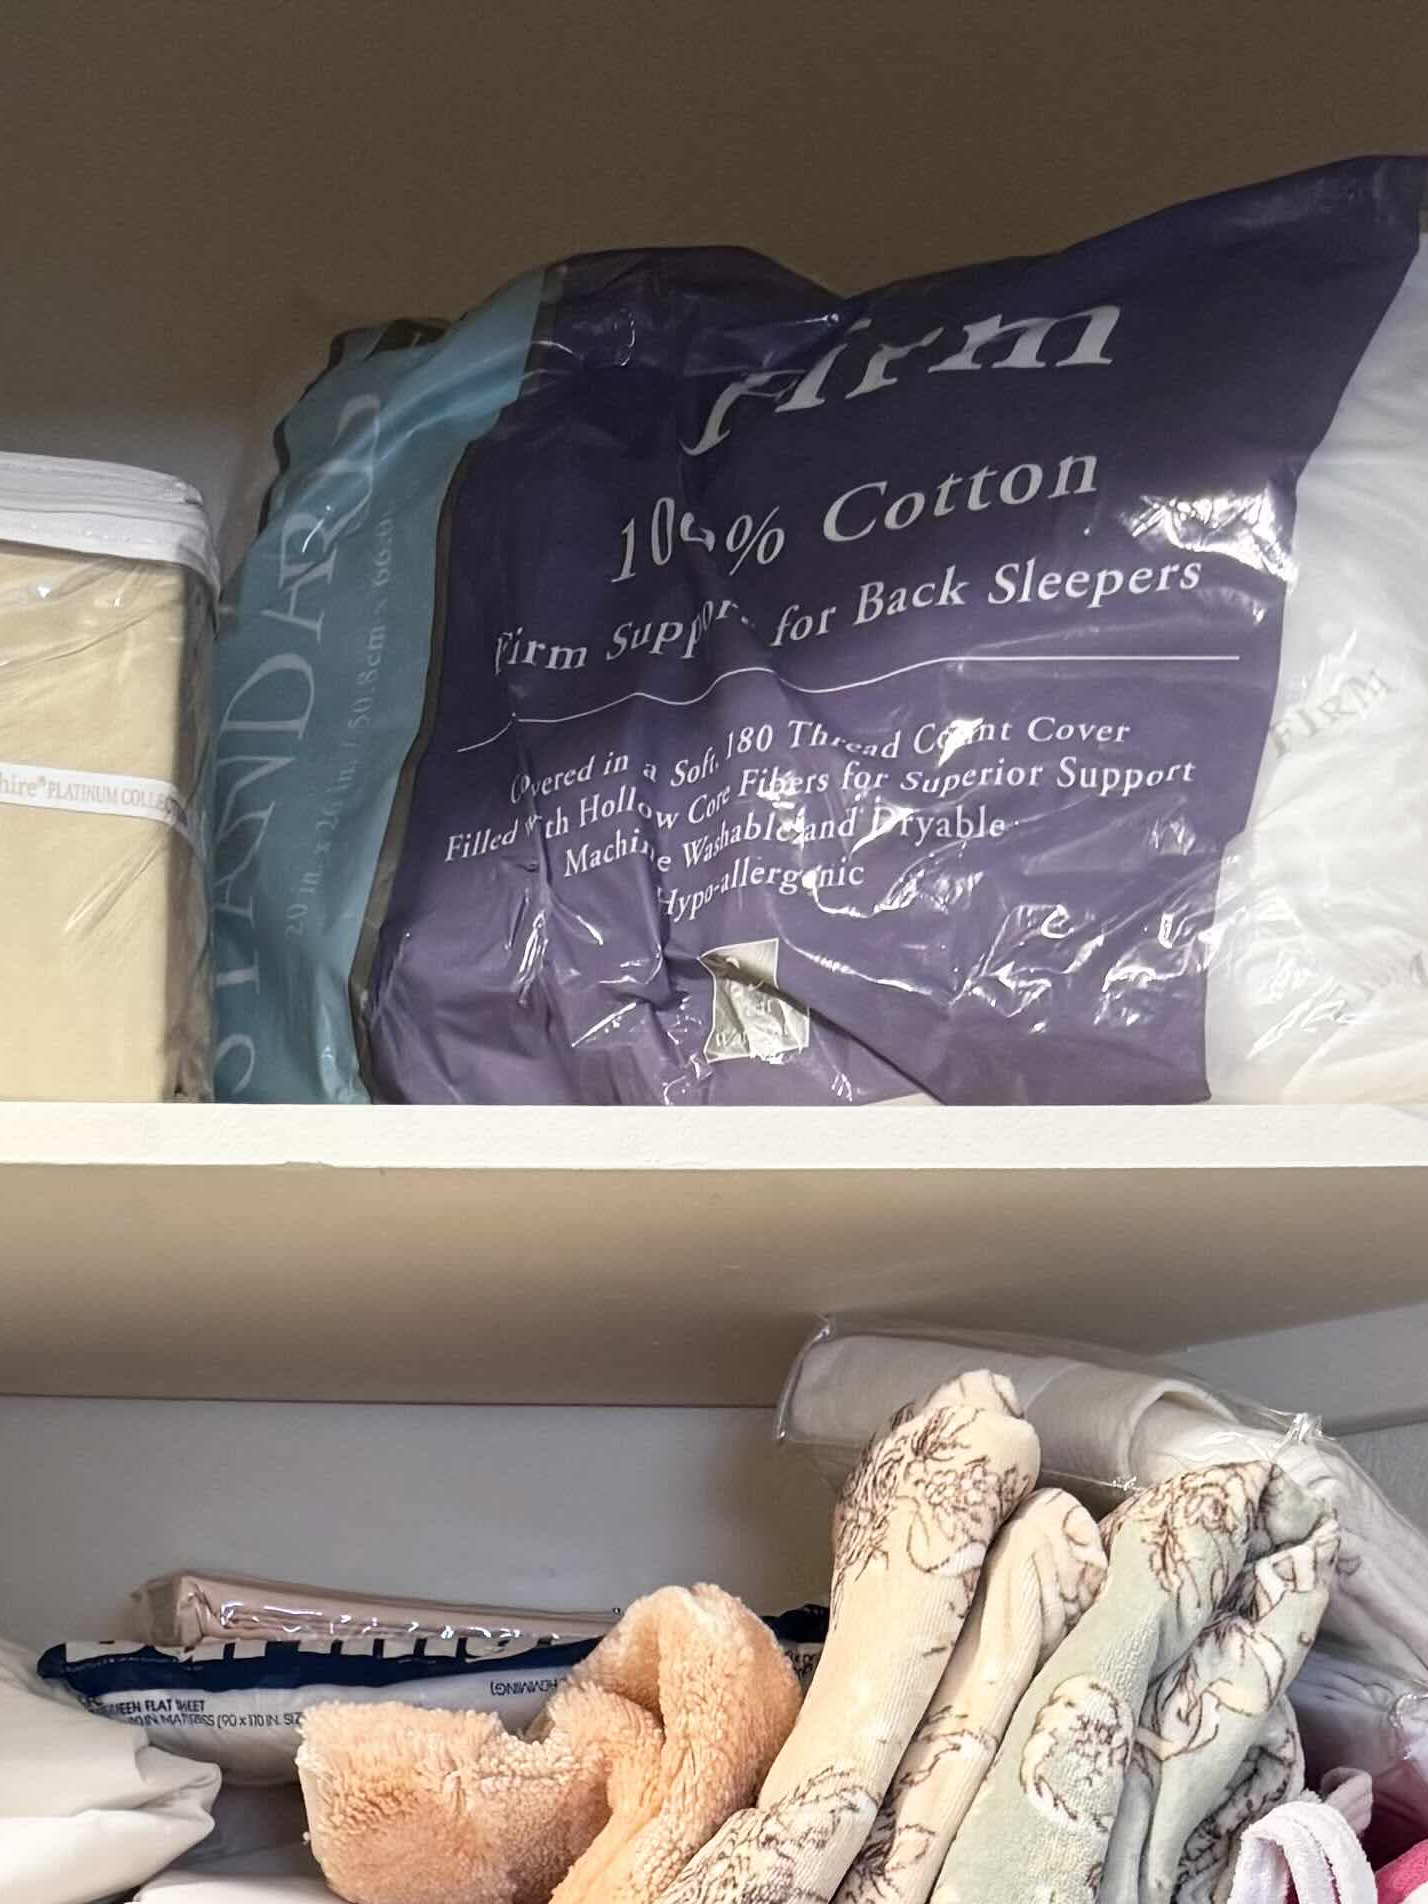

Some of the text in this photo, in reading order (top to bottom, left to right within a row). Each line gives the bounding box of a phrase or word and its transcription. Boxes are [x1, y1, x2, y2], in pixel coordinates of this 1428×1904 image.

[680, 304, 1120, 456] Firm
[823, 454, 1098, 544] Cotton
[495, 625, 588, 675] Firm
[771, 604, 836, 647] for
[853, 565, 970, 627] Back
[987, 557, 1202, 609] Sleepers
[603, 750, 629, 776] in
[724, 724, 773, 759] 180
[787, 720, 901, 759] Thread
[1027, 716, 1131, 744] Cover
[1269, 669, 1393, 758] FIRM
[46, 782, 119, 805] PLATINUM
[444, 824, 518, 862] Filled
[578, 785, 679, 831] Hollow
[687, 786, 731, 824] Core
[842, 760, 890, 792] for
[899, 758, 1045, 798] Superior
[1056, 755, 1197, 798] Support
[145, 1699, 173, 1713] FLAT
